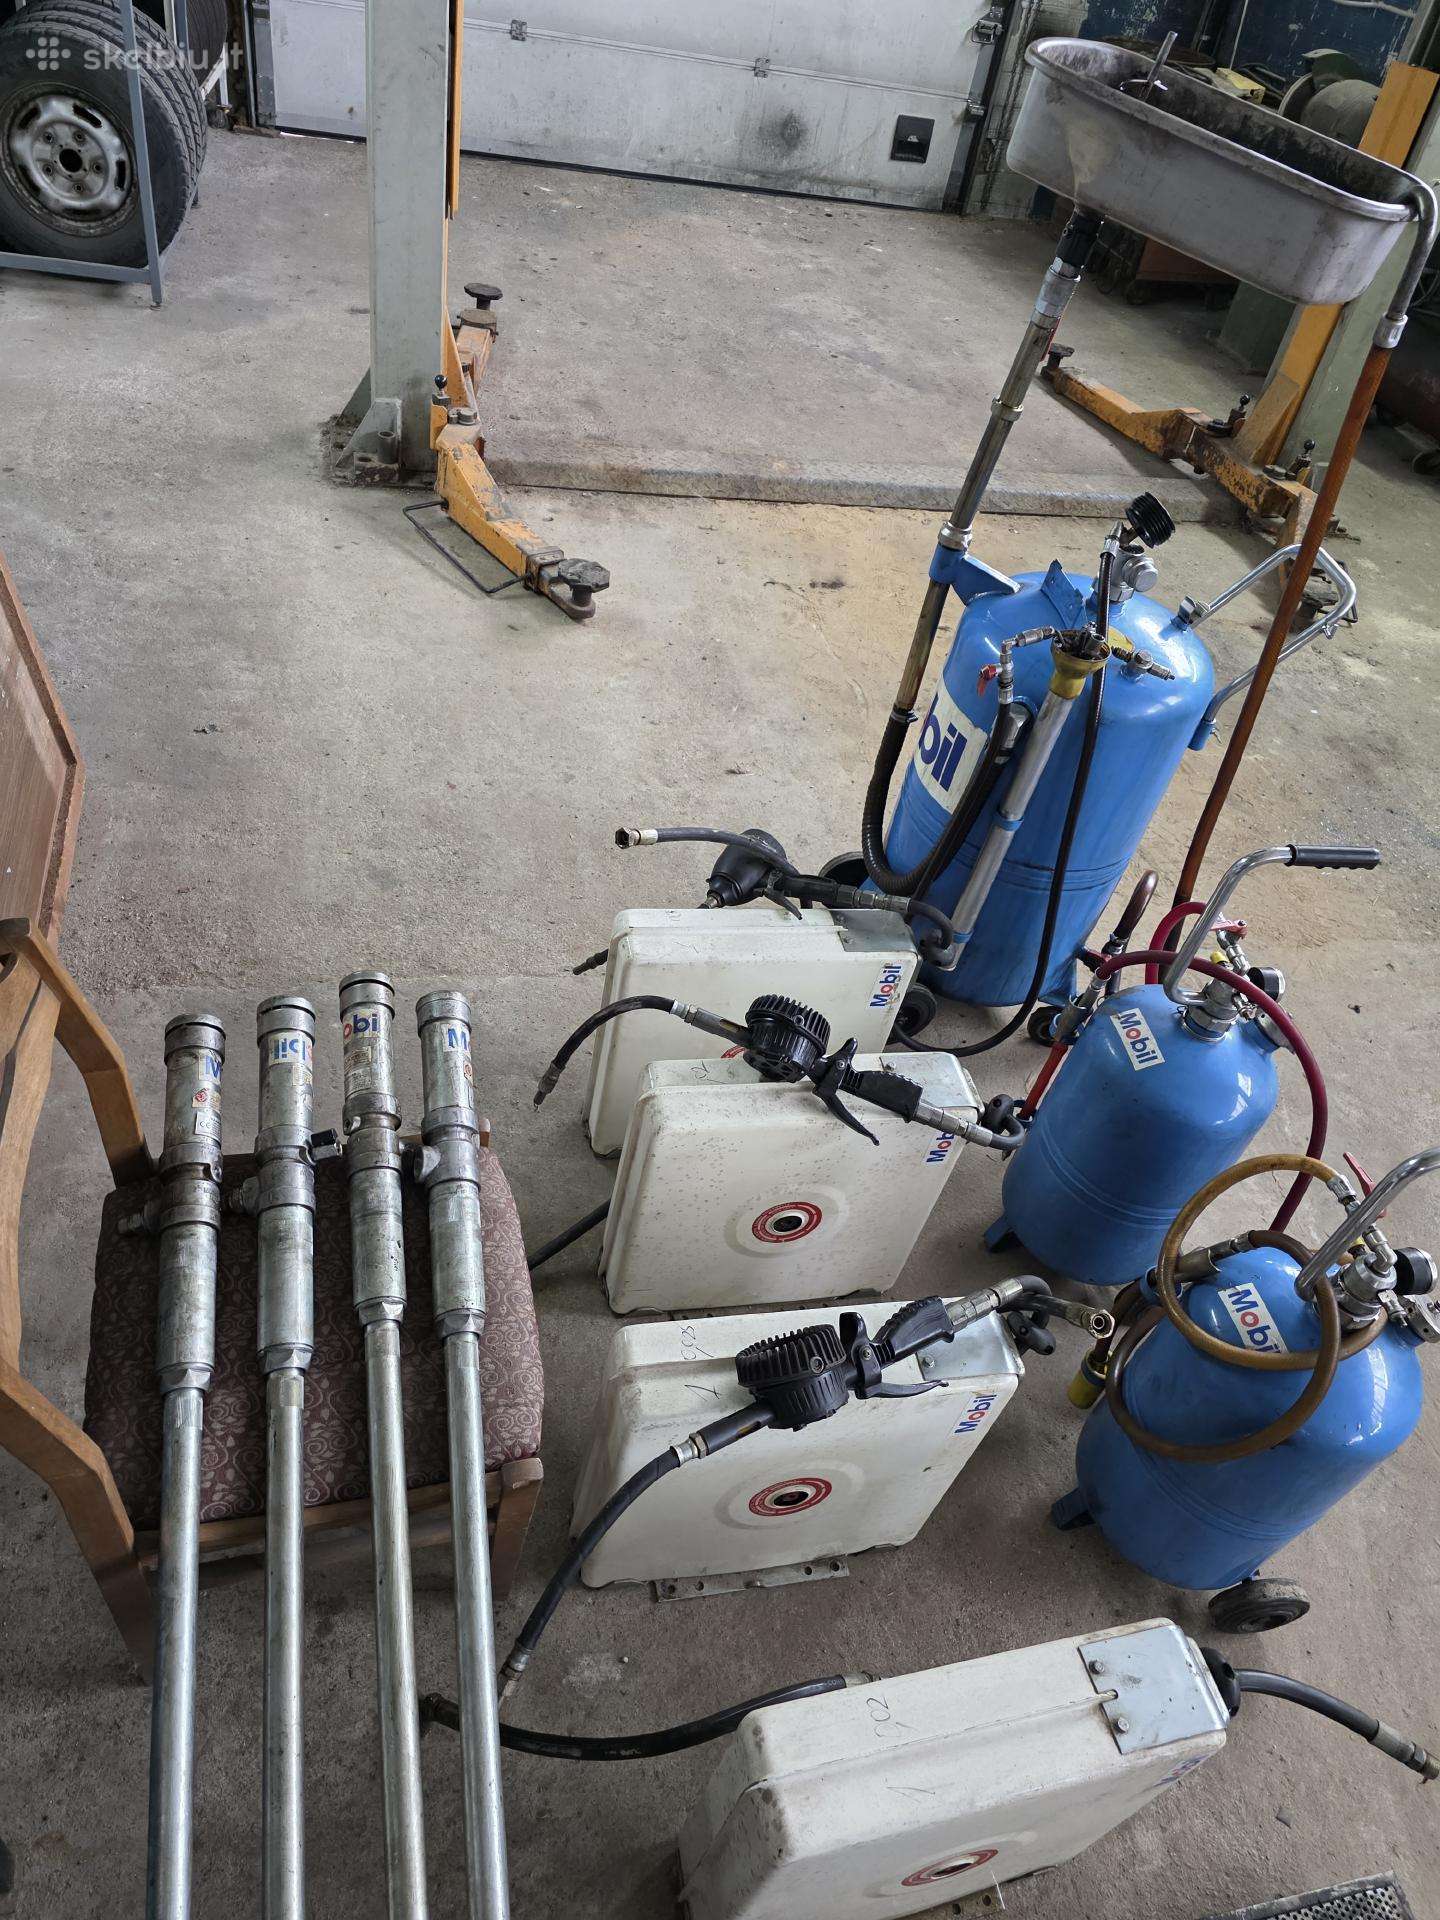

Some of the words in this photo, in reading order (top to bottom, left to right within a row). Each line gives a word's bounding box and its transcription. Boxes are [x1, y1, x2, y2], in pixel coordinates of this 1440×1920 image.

[870, 965, 902, 1007] Mobil
[1120, 1012, 1158, 1064] Mobil
[1227, 1289, 1281, 1353] Mobi
[954, 1394, 997, 1434] Mobil
